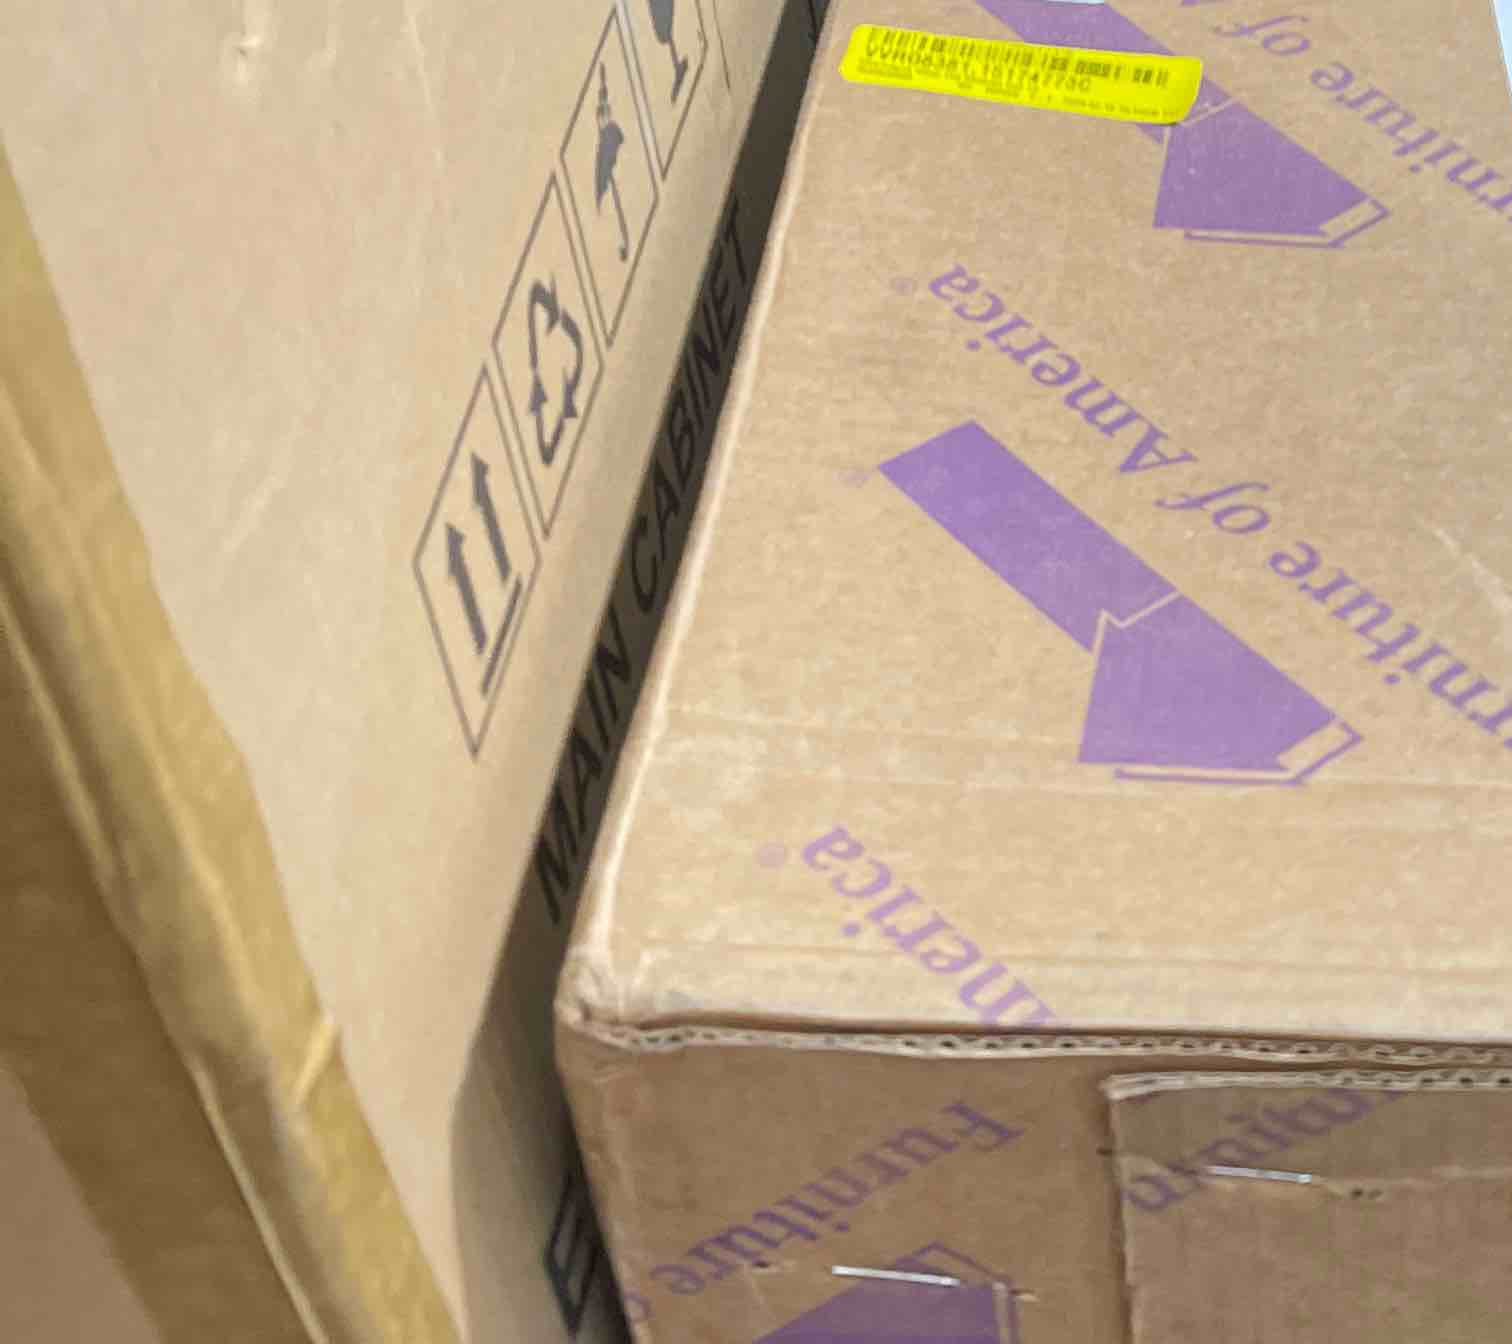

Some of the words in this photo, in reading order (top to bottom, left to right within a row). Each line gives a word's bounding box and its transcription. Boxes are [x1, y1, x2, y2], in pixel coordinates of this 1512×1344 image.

[1212, 14, 1312, 57] of
[926, 263, 1200, 476] America
[1154, 479, 1272, 536] of
[802, 823, 1064, 1030] merica
[648, 1101, 1025, 1297] Furniture
